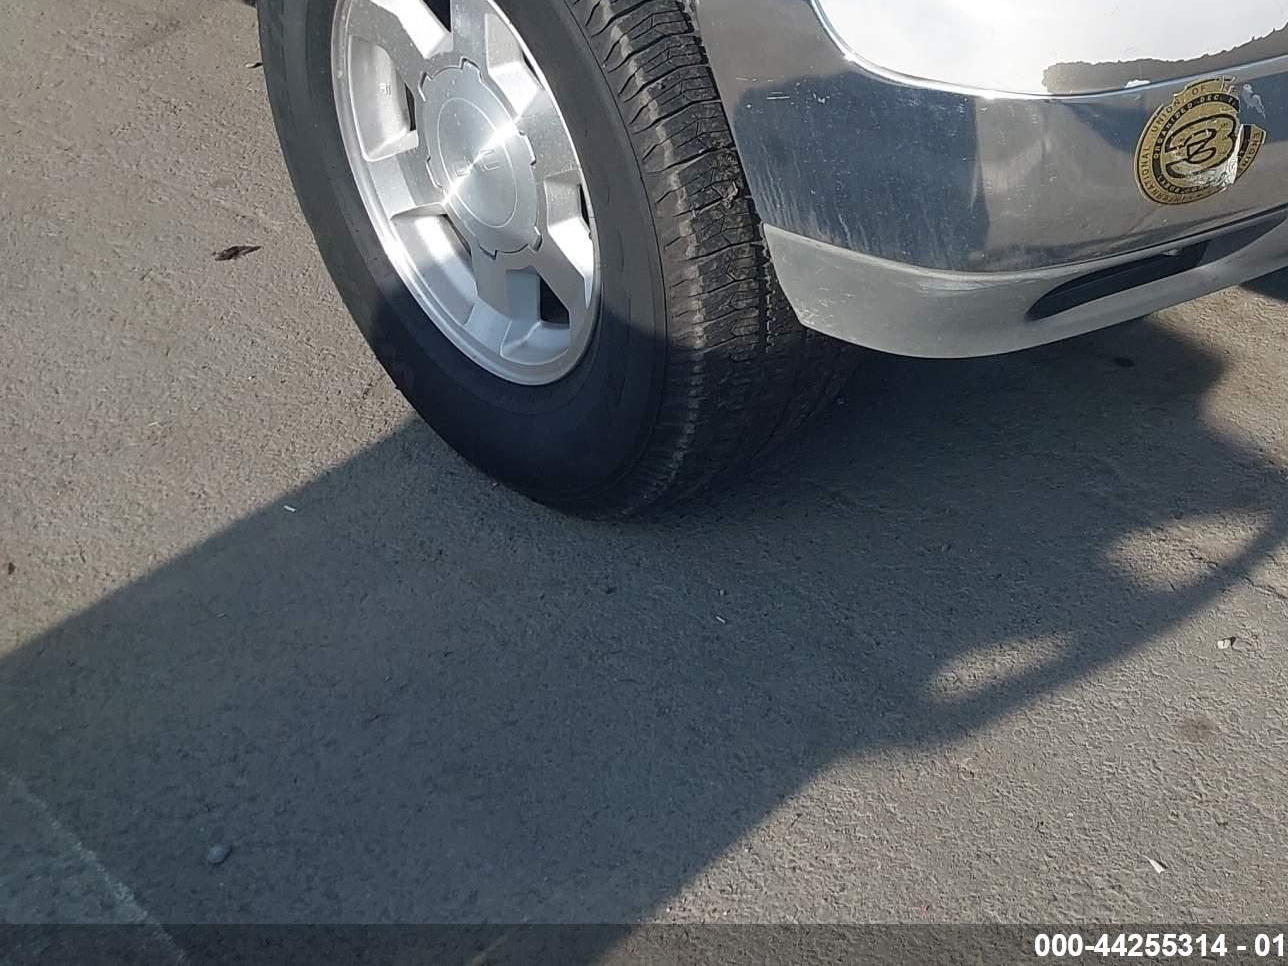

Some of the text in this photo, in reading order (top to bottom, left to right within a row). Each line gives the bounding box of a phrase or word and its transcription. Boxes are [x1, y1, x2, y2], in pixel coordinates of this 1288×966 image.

[1141, 84, 1207, 203] INTERNATIONAL UNION OF
[1152, 101, 1194, 160] ORGANIZED
